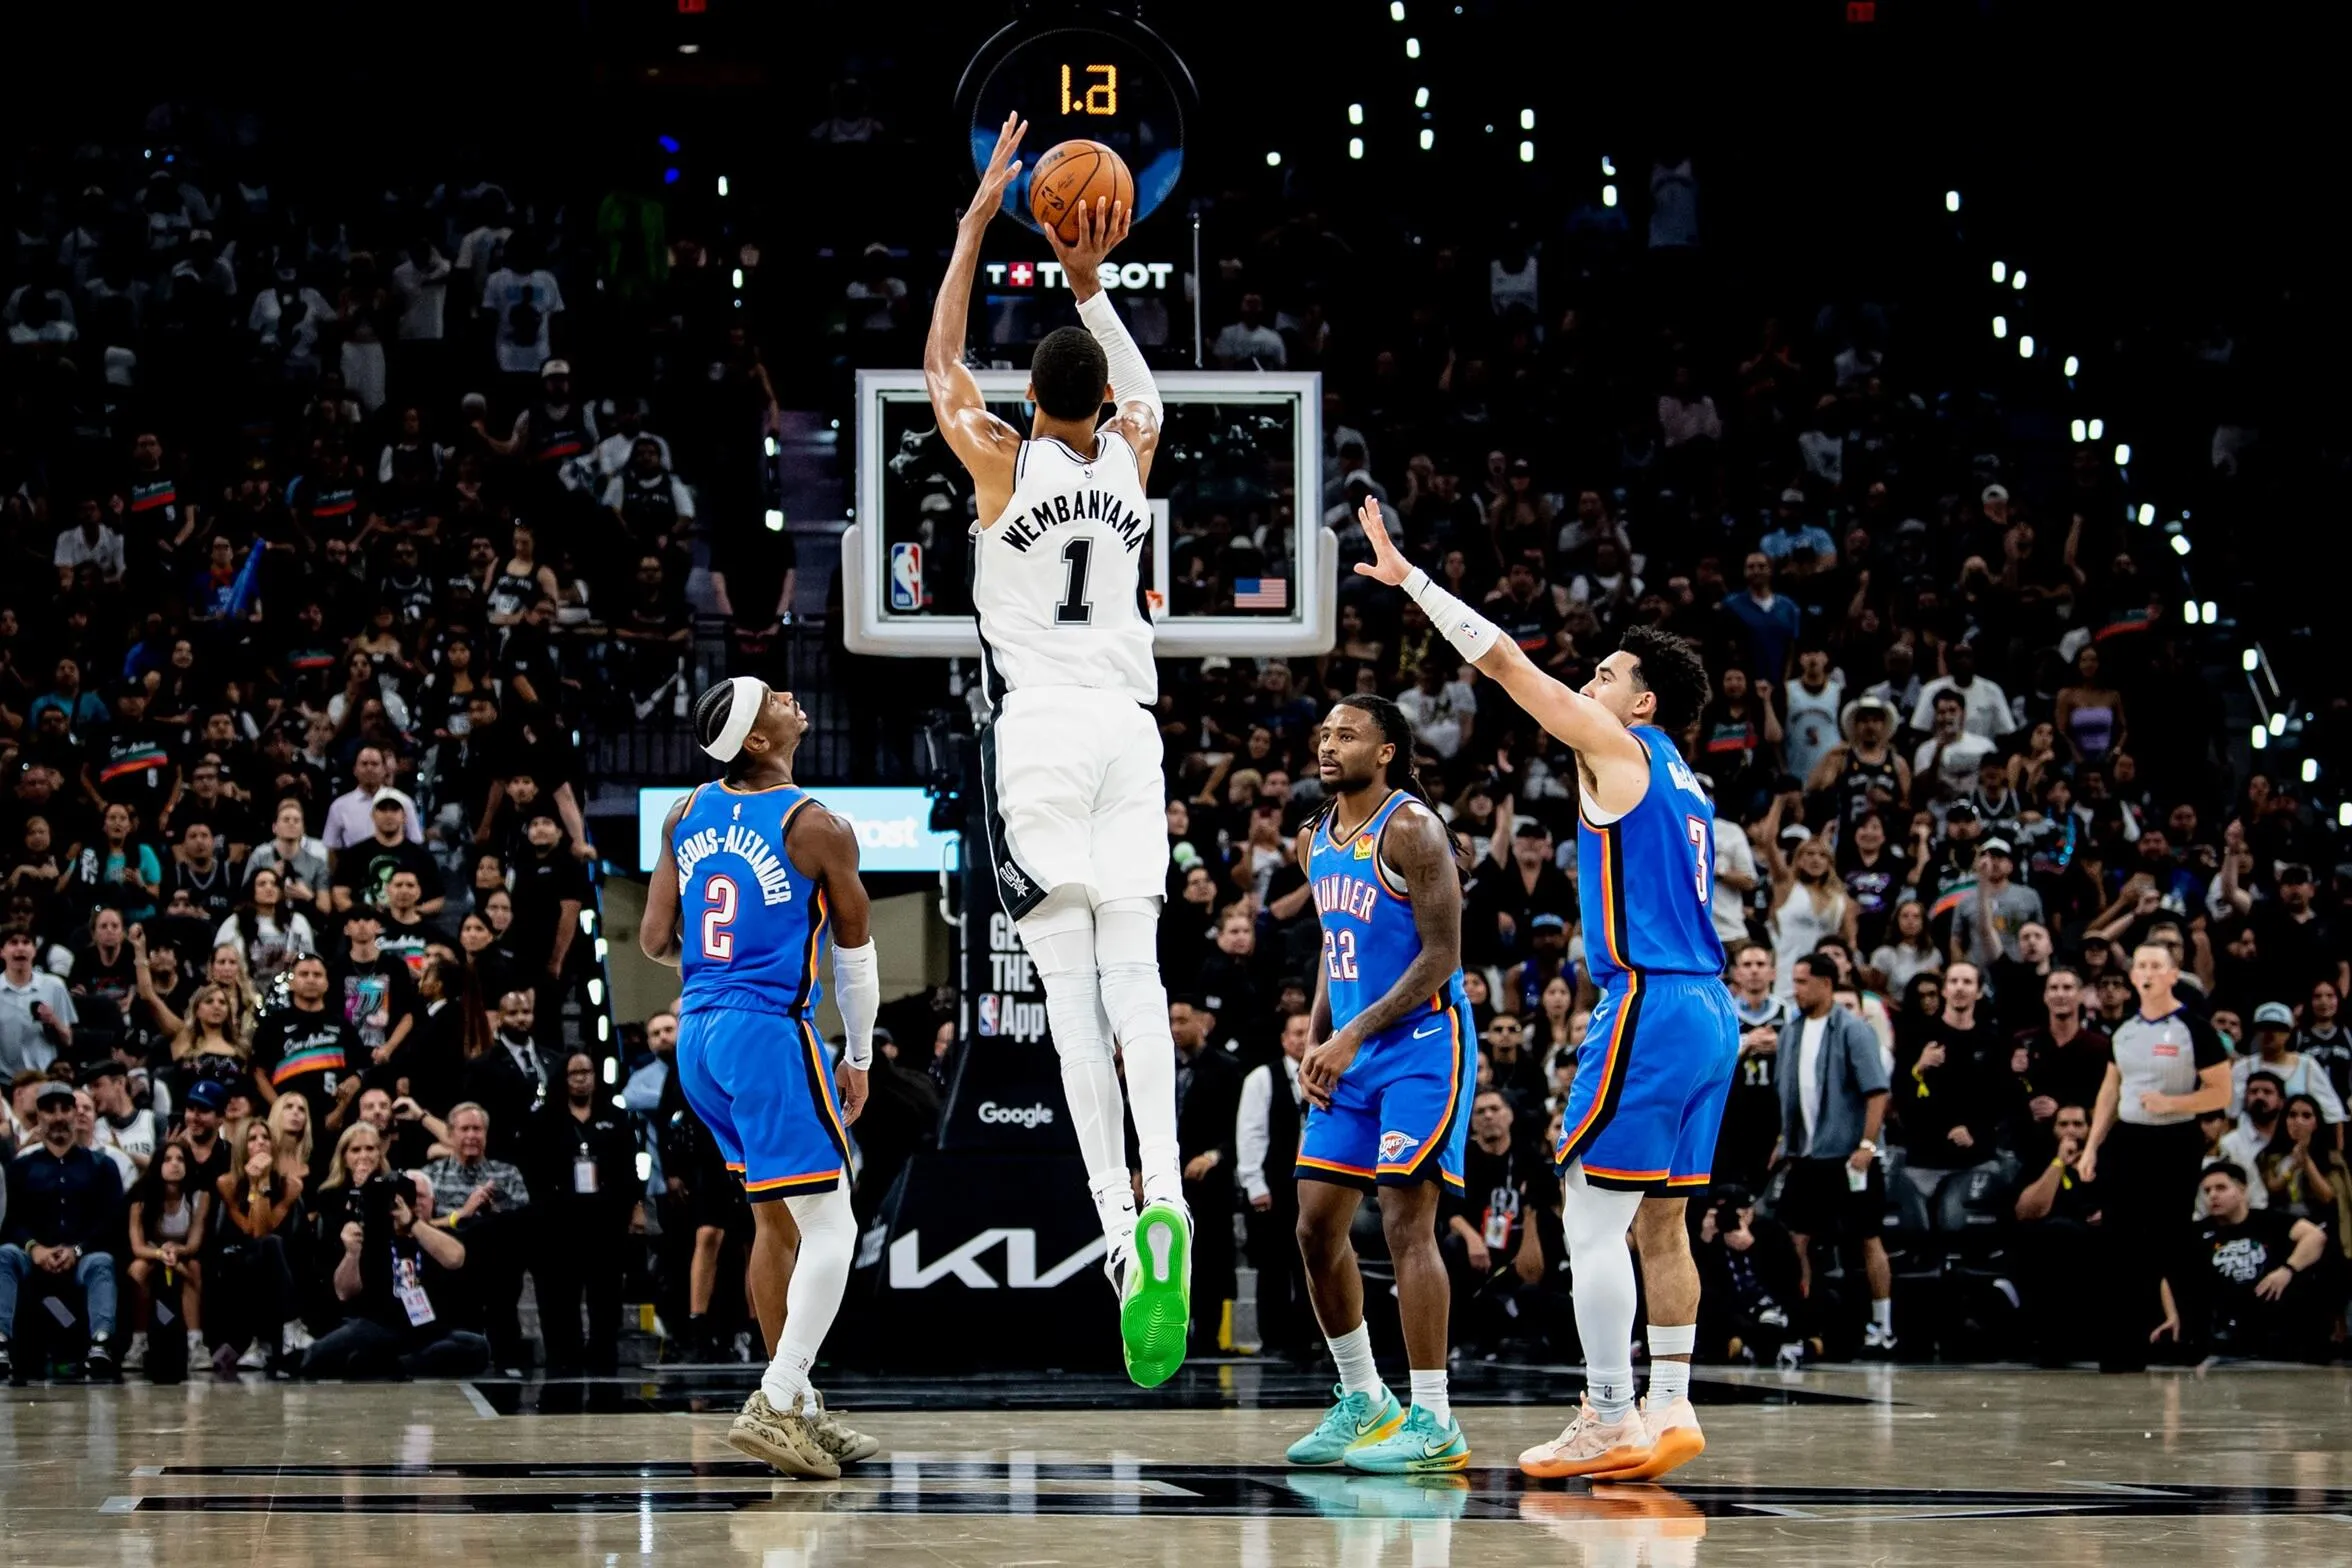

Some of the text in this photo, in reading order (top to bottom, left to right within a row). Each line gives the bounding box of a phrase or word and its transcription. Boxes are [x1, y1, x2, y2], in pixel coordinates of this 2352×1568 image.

[1036, 262, 1174, 290] TISOT
[1000, 489, 1146, 554] WEMBANYAMA
[1054, 535, 1095, 626] 1
[1686, 813, 1708, 905] 3
[702, 874, 739, 962] 2
[990, 911, 1029, 952] GE
[989, 952, 1036, 993] THE
[1323, 928, 1360, 982] 22
[1000, 994, 1046, 1044] App
[978, 1101, 1054, 1129] Google
